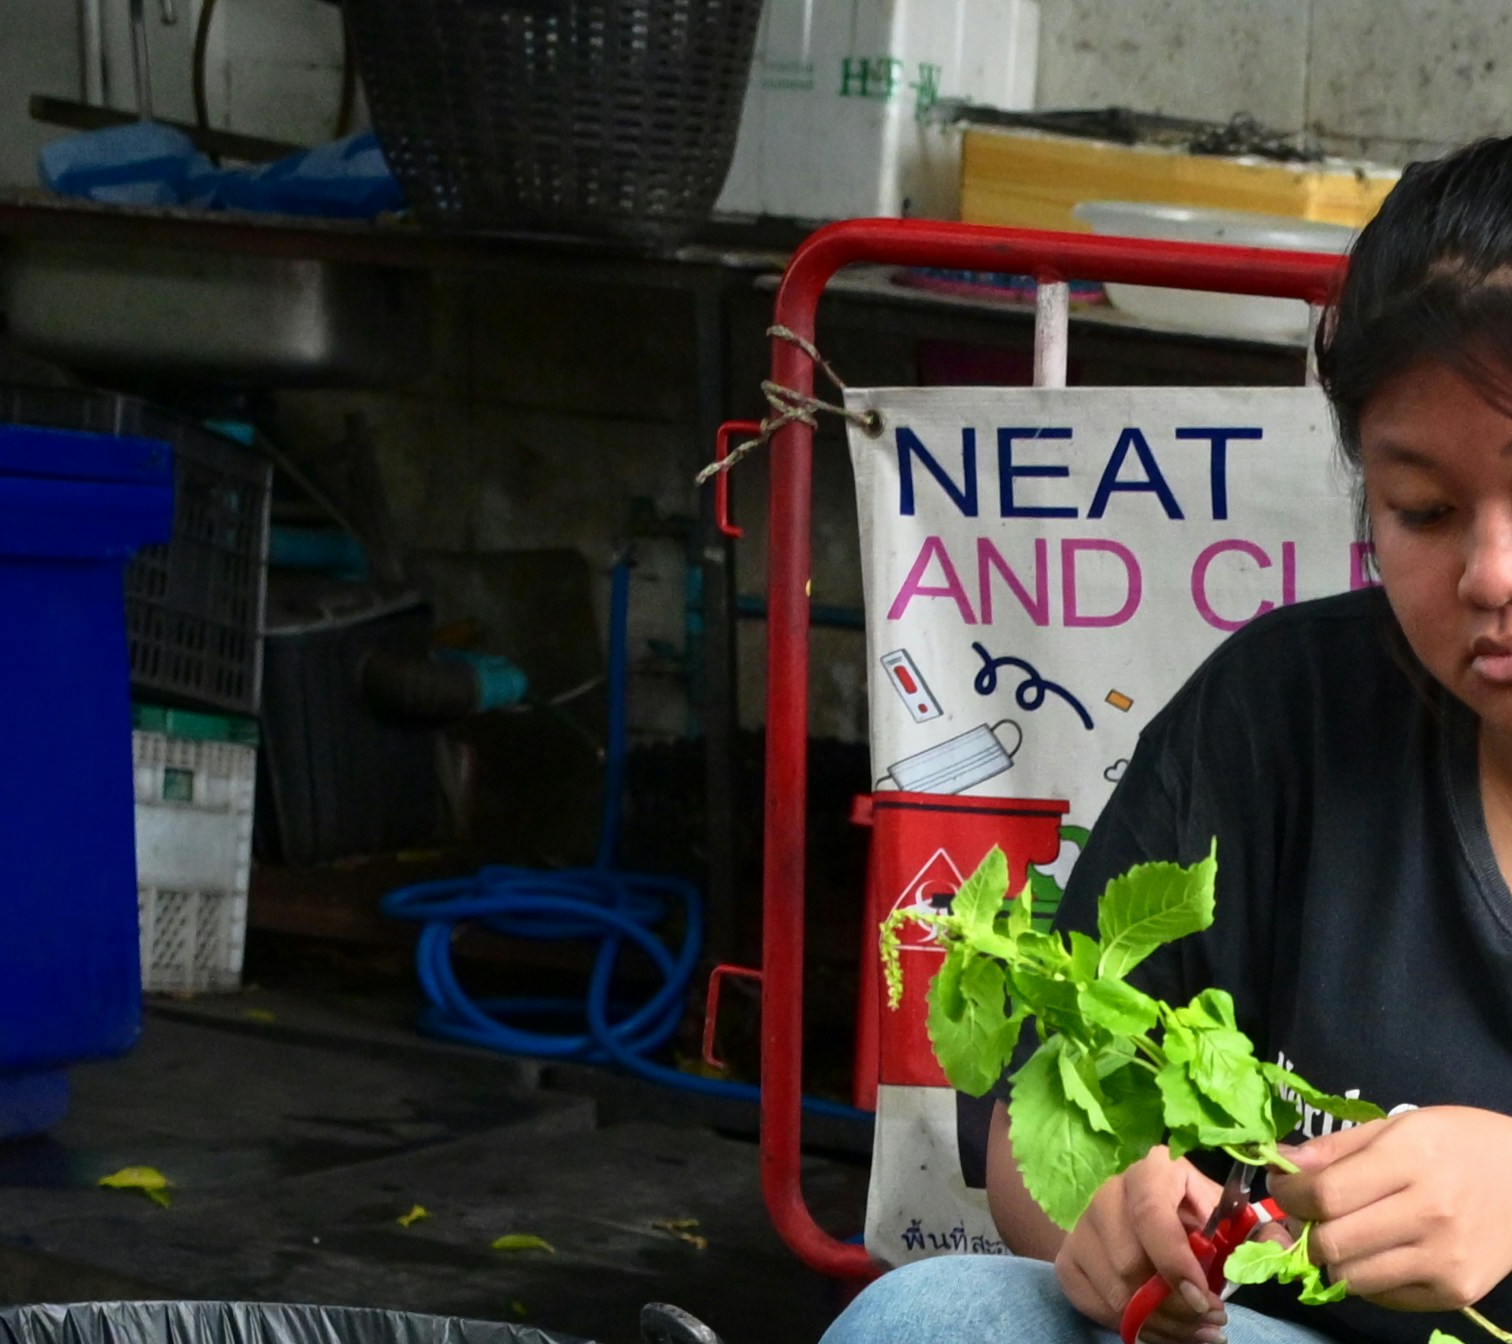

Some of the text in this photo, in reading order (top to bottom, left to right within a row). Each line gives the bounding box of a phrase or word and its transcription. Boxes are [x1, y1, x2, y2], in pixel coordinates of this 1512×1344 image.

[895, 427, 1263, 520] NEAT
[887, 536, 1384, 632] AND CL
